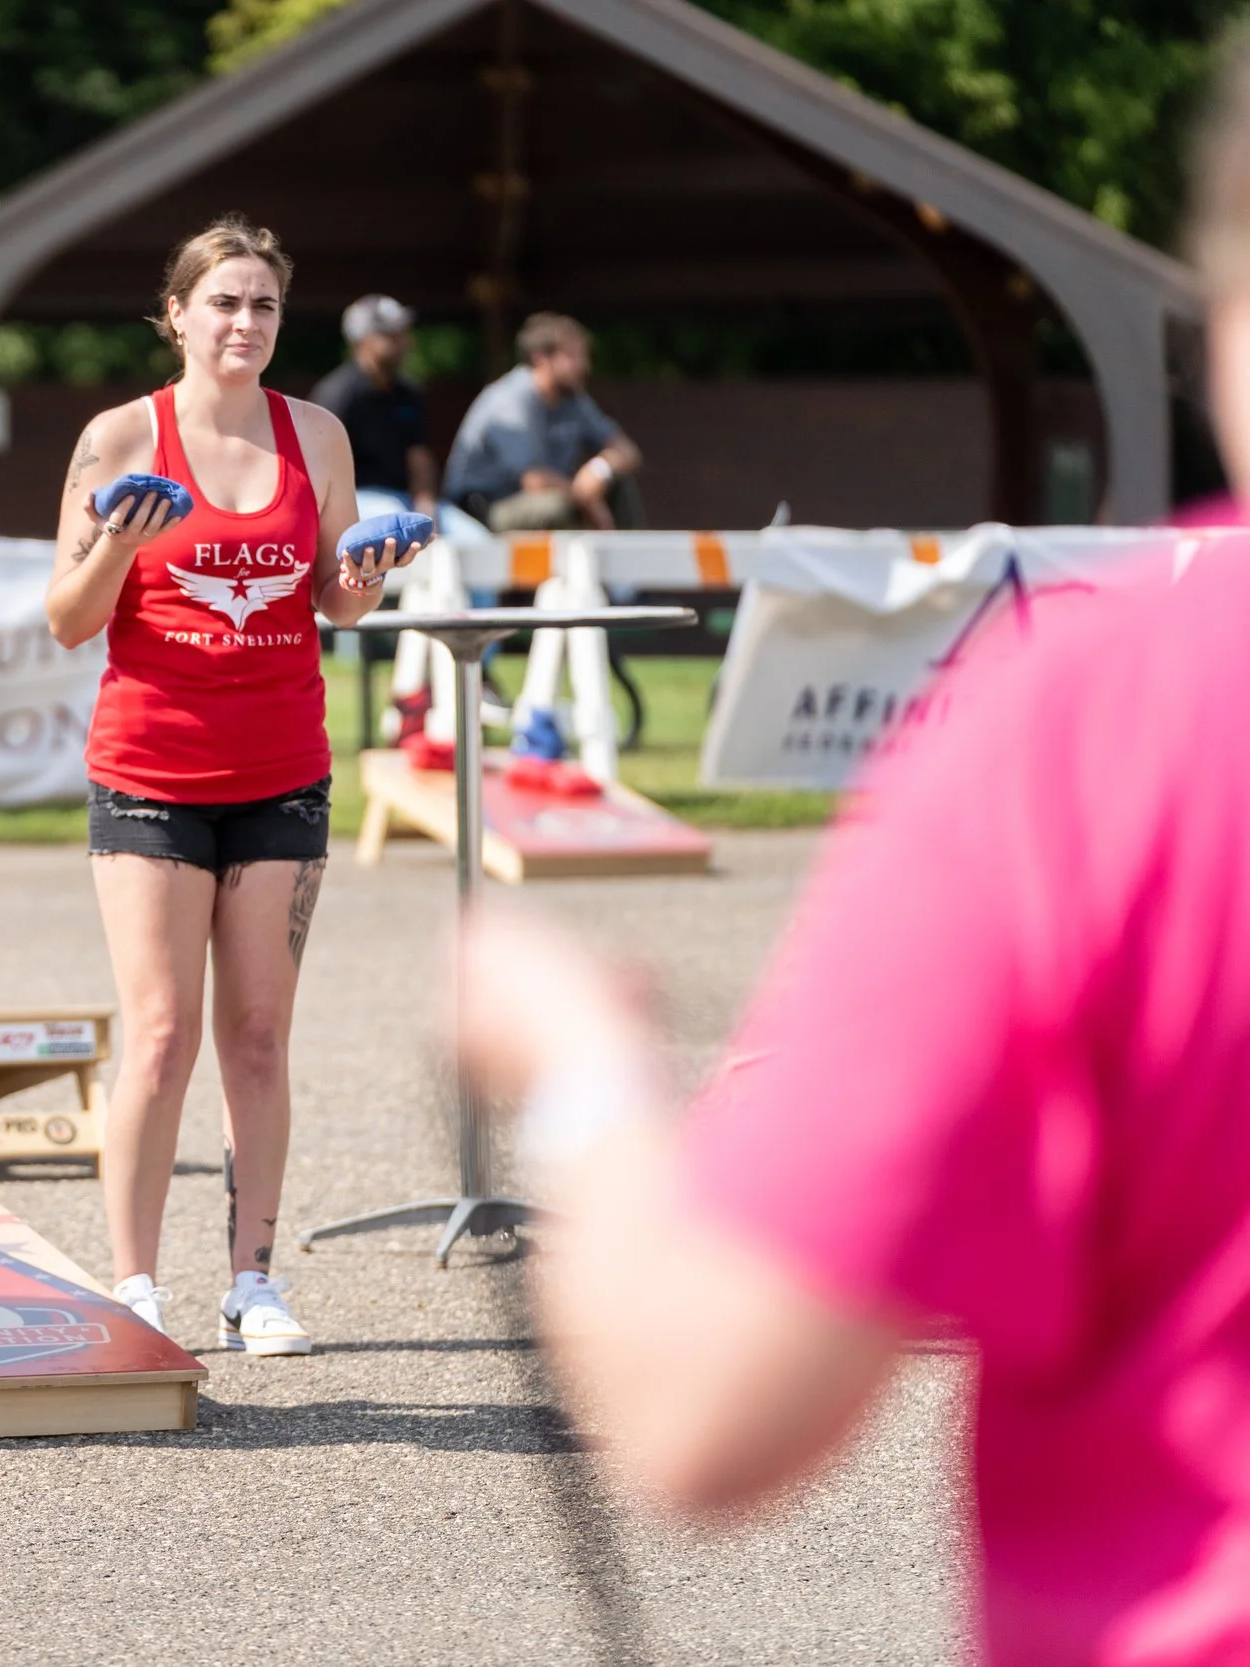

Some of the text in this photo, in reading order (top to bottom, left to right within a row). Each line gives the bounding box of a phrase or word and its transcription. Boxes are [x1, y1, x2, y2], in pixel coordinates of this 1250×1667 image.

[194, 542, 296, 567] FLAGS
[233, 566, 252, 579] for
[164, 631, 303, 647] FORT SNELLING
